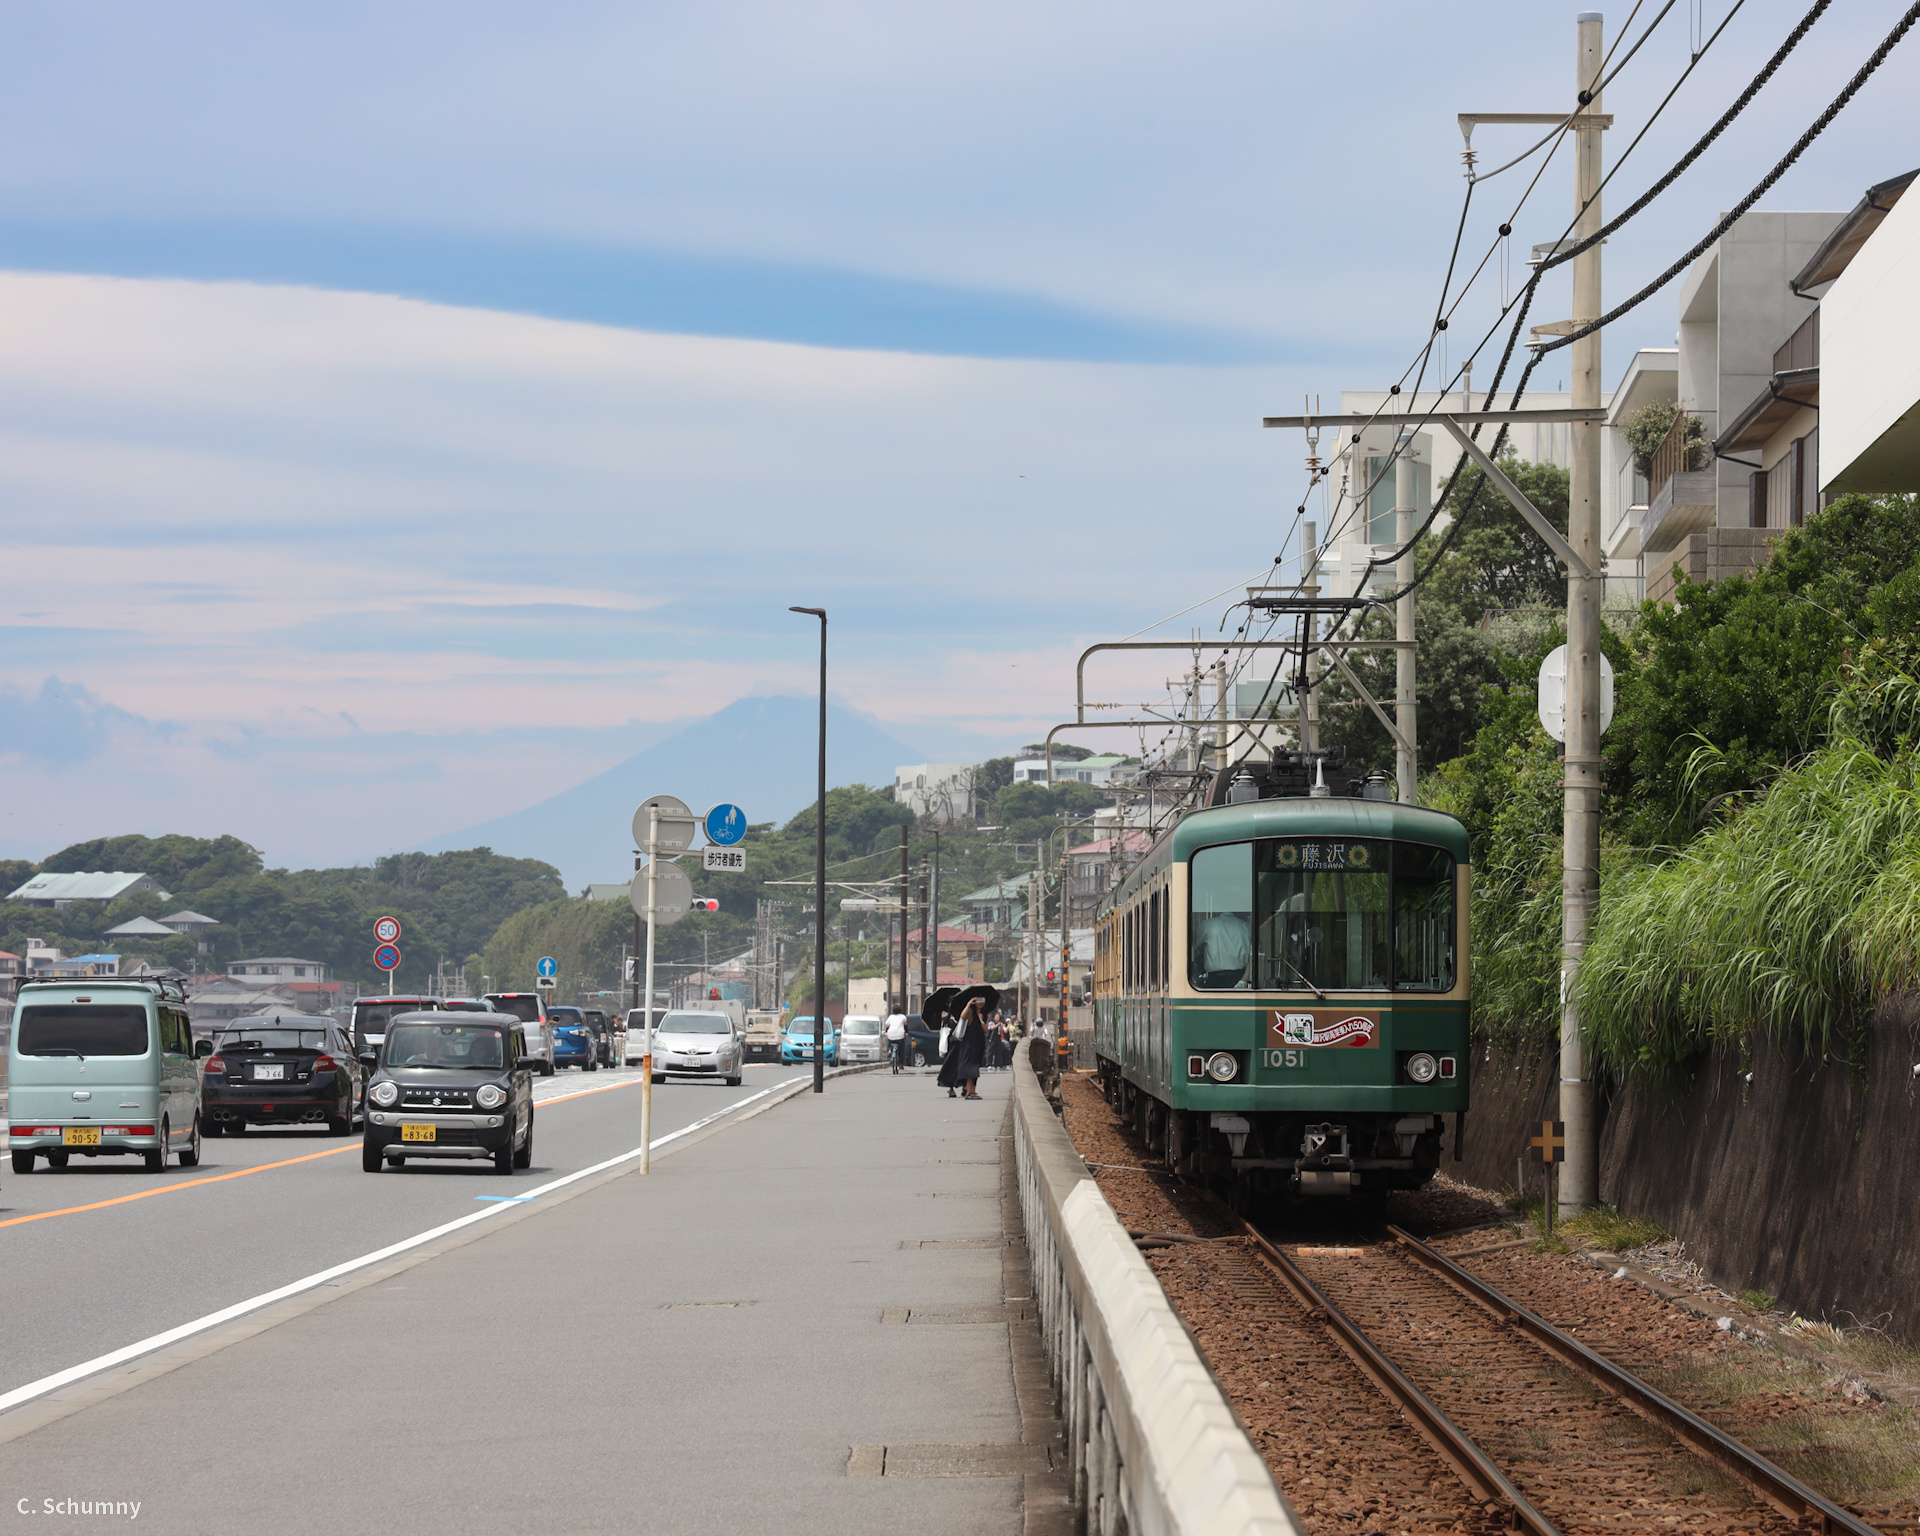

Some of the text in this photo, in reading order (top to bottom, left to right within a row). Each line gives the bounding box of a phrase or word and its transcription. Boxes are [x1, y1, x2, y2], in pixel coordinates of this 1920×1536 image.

[708, 852, 742, 867] 歩行者優先
[1301, 844, 1345, 863] 藤沢
[380, 924, 395, 936] 50
[1263, 1050, 1304, 1067] 1051
[72, 1134, 98, 1143] 90-52
[409, 1131, 434, 1140] 83-68
